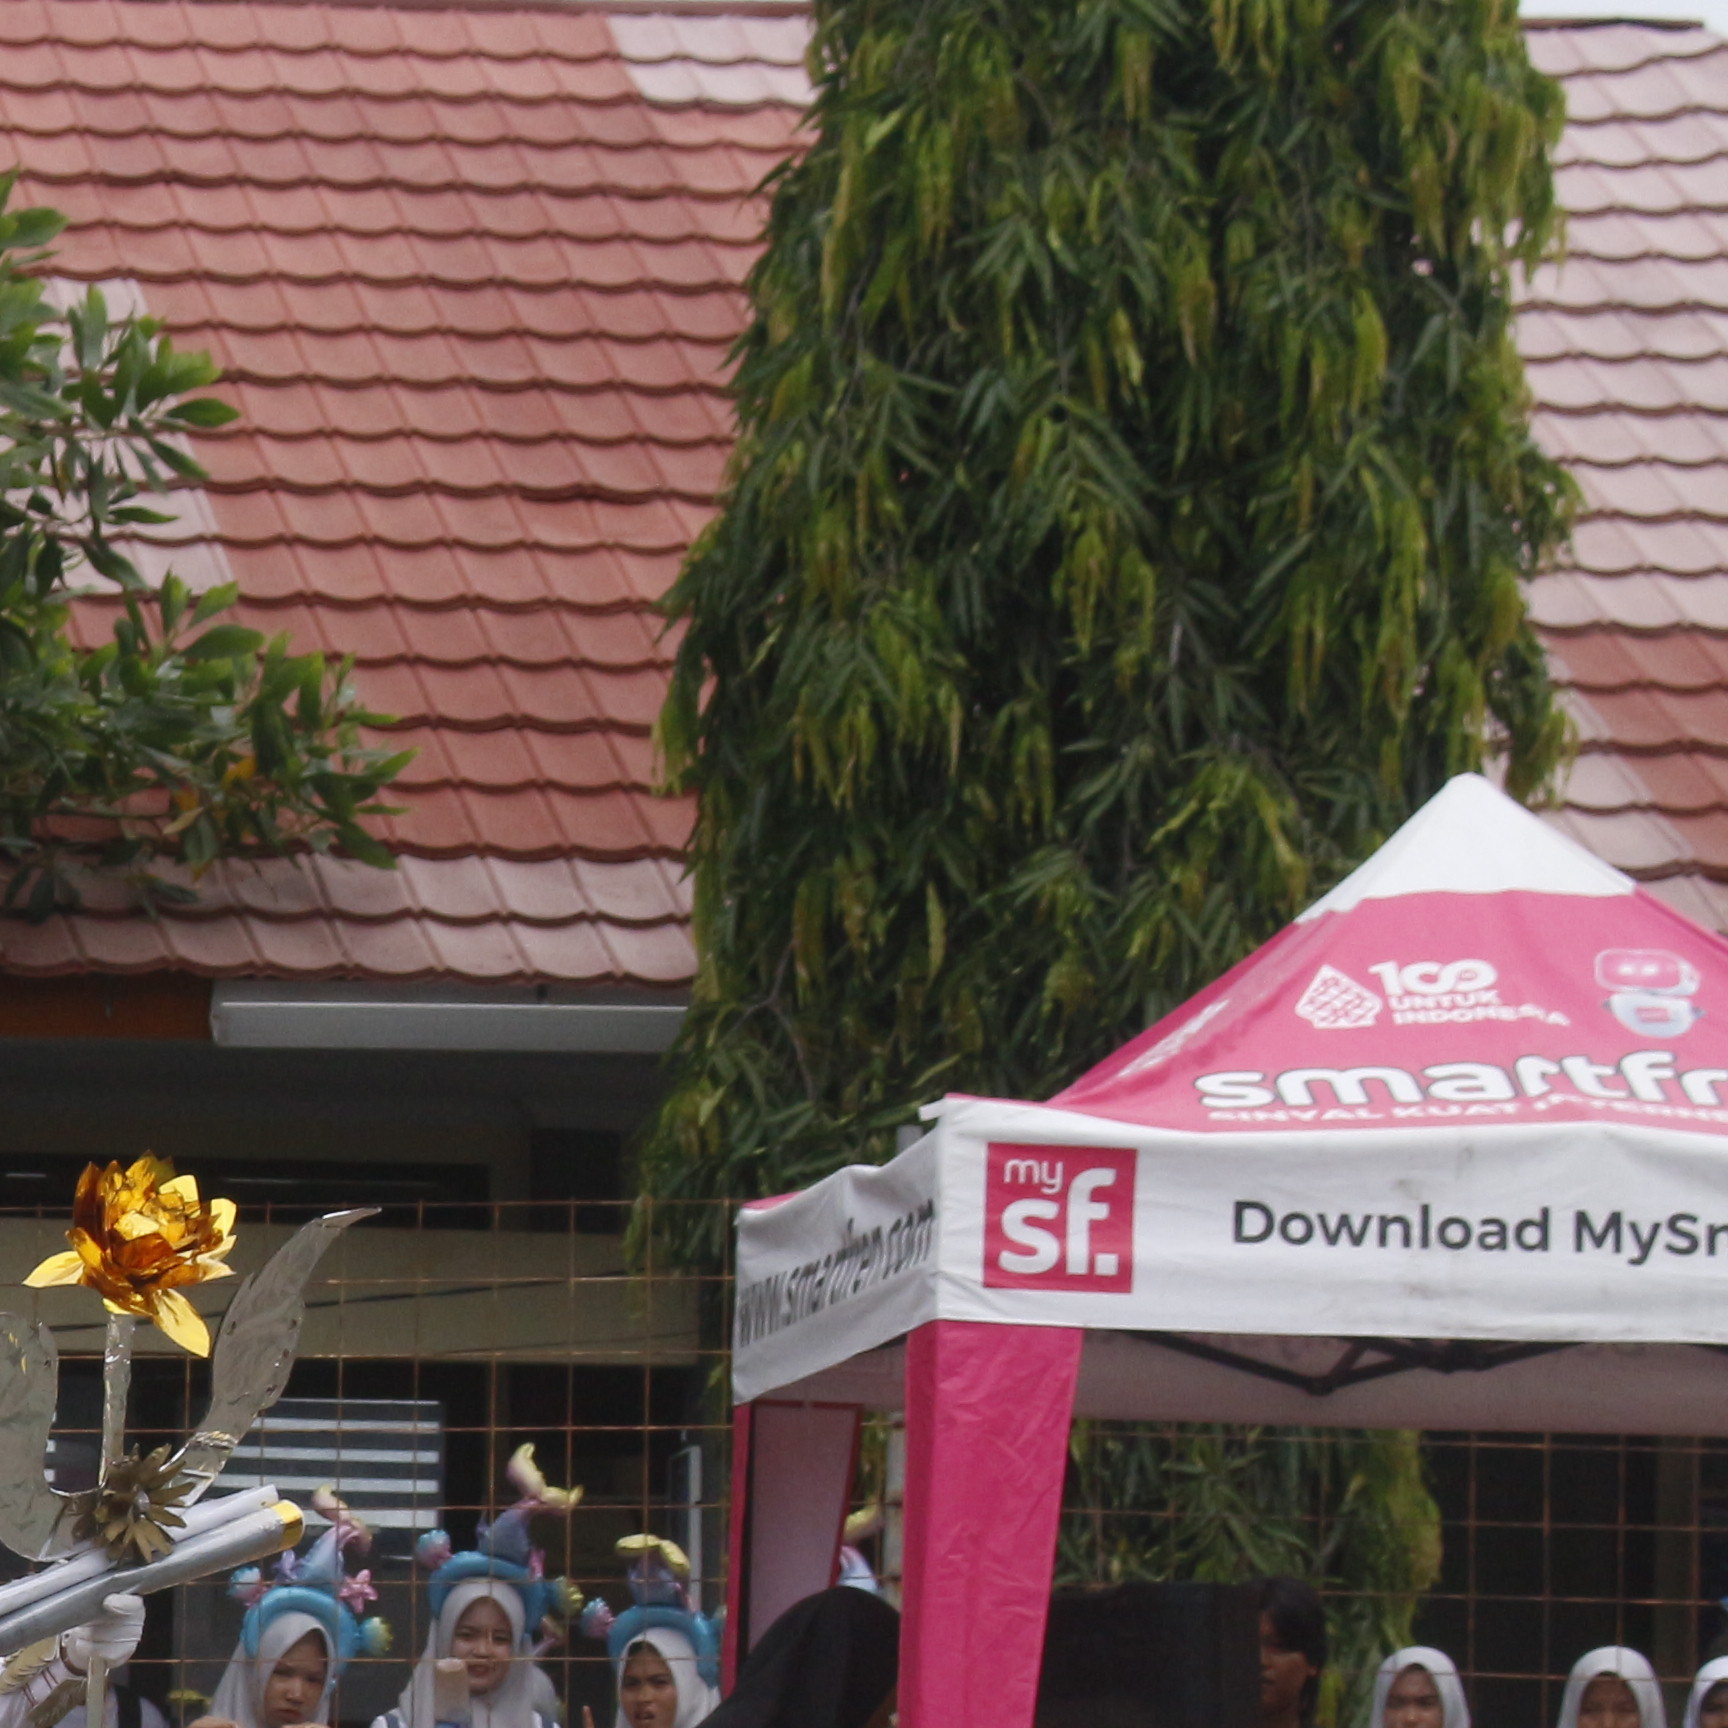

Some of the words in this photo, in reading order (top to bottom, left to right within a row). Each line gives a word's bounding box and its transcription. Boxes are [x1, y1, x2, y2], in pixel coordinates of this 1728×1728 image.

[1389, 990, 1501, 1011] UNTUK
[1003, 1157, 1064, 1195] my
[1233, 1199, 1550, 1253] Download
